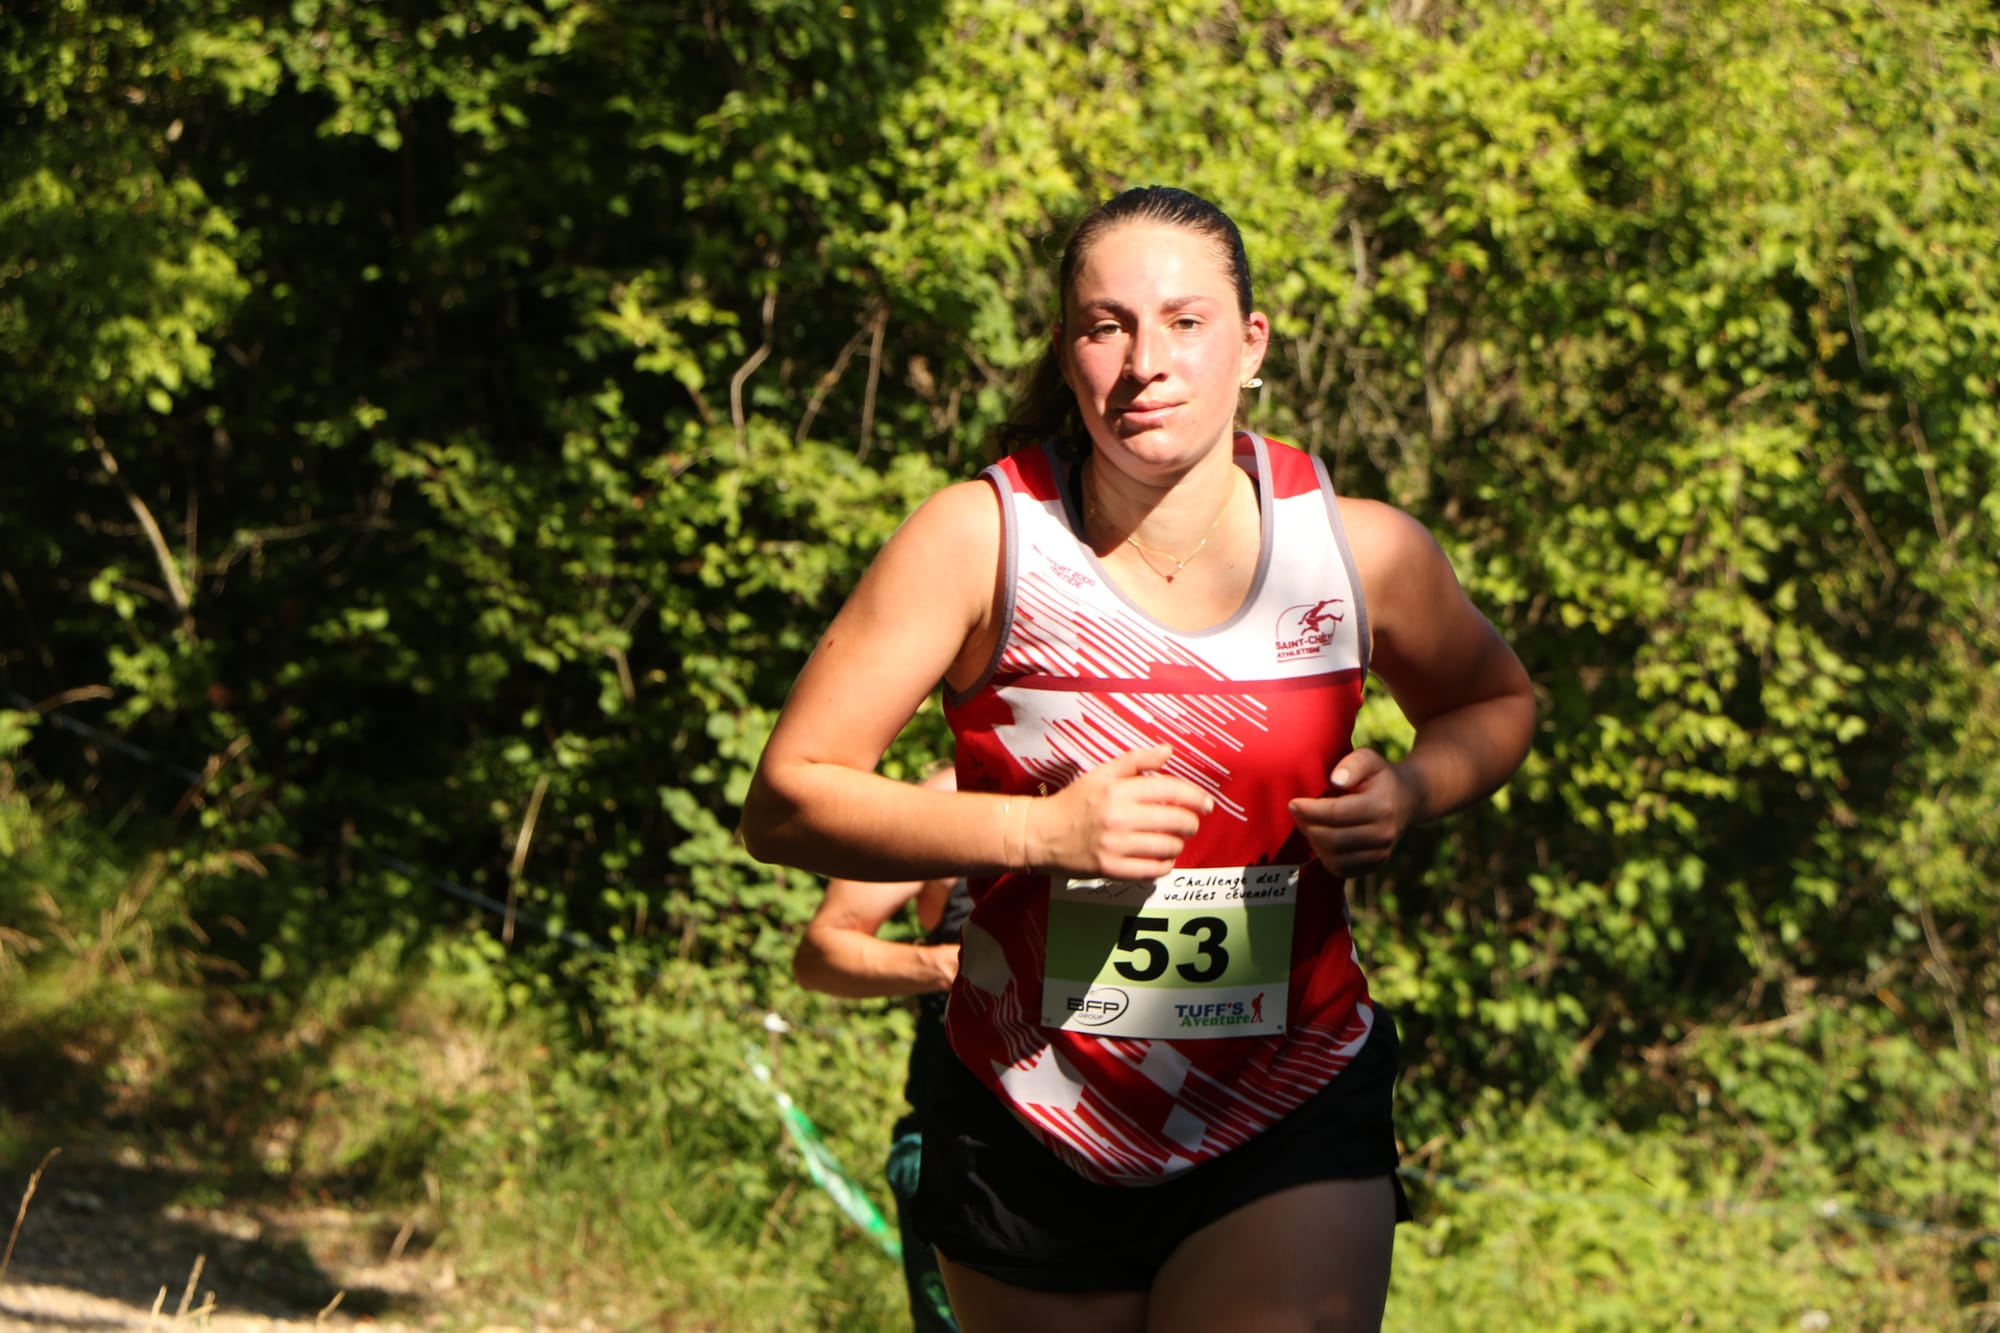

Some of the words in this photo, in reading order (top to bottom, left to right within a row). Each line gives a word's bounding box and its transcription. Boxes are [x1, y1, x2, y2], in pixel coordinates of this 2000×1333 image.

[1173, 875, 1247, 890] Challenge
[1256, 872, 1281, 885] des
[1164, 889, 1216, 901] vallées
[1225, 886, 1287, 900] cévenoles
[1113, 915, 1230, 983] 53
[1067, 997, 1120, 1015] BFP
[1174, 1002, 1244, 1018] TUFF'S
[1180, 1013, 1251, 1028] Aventure
